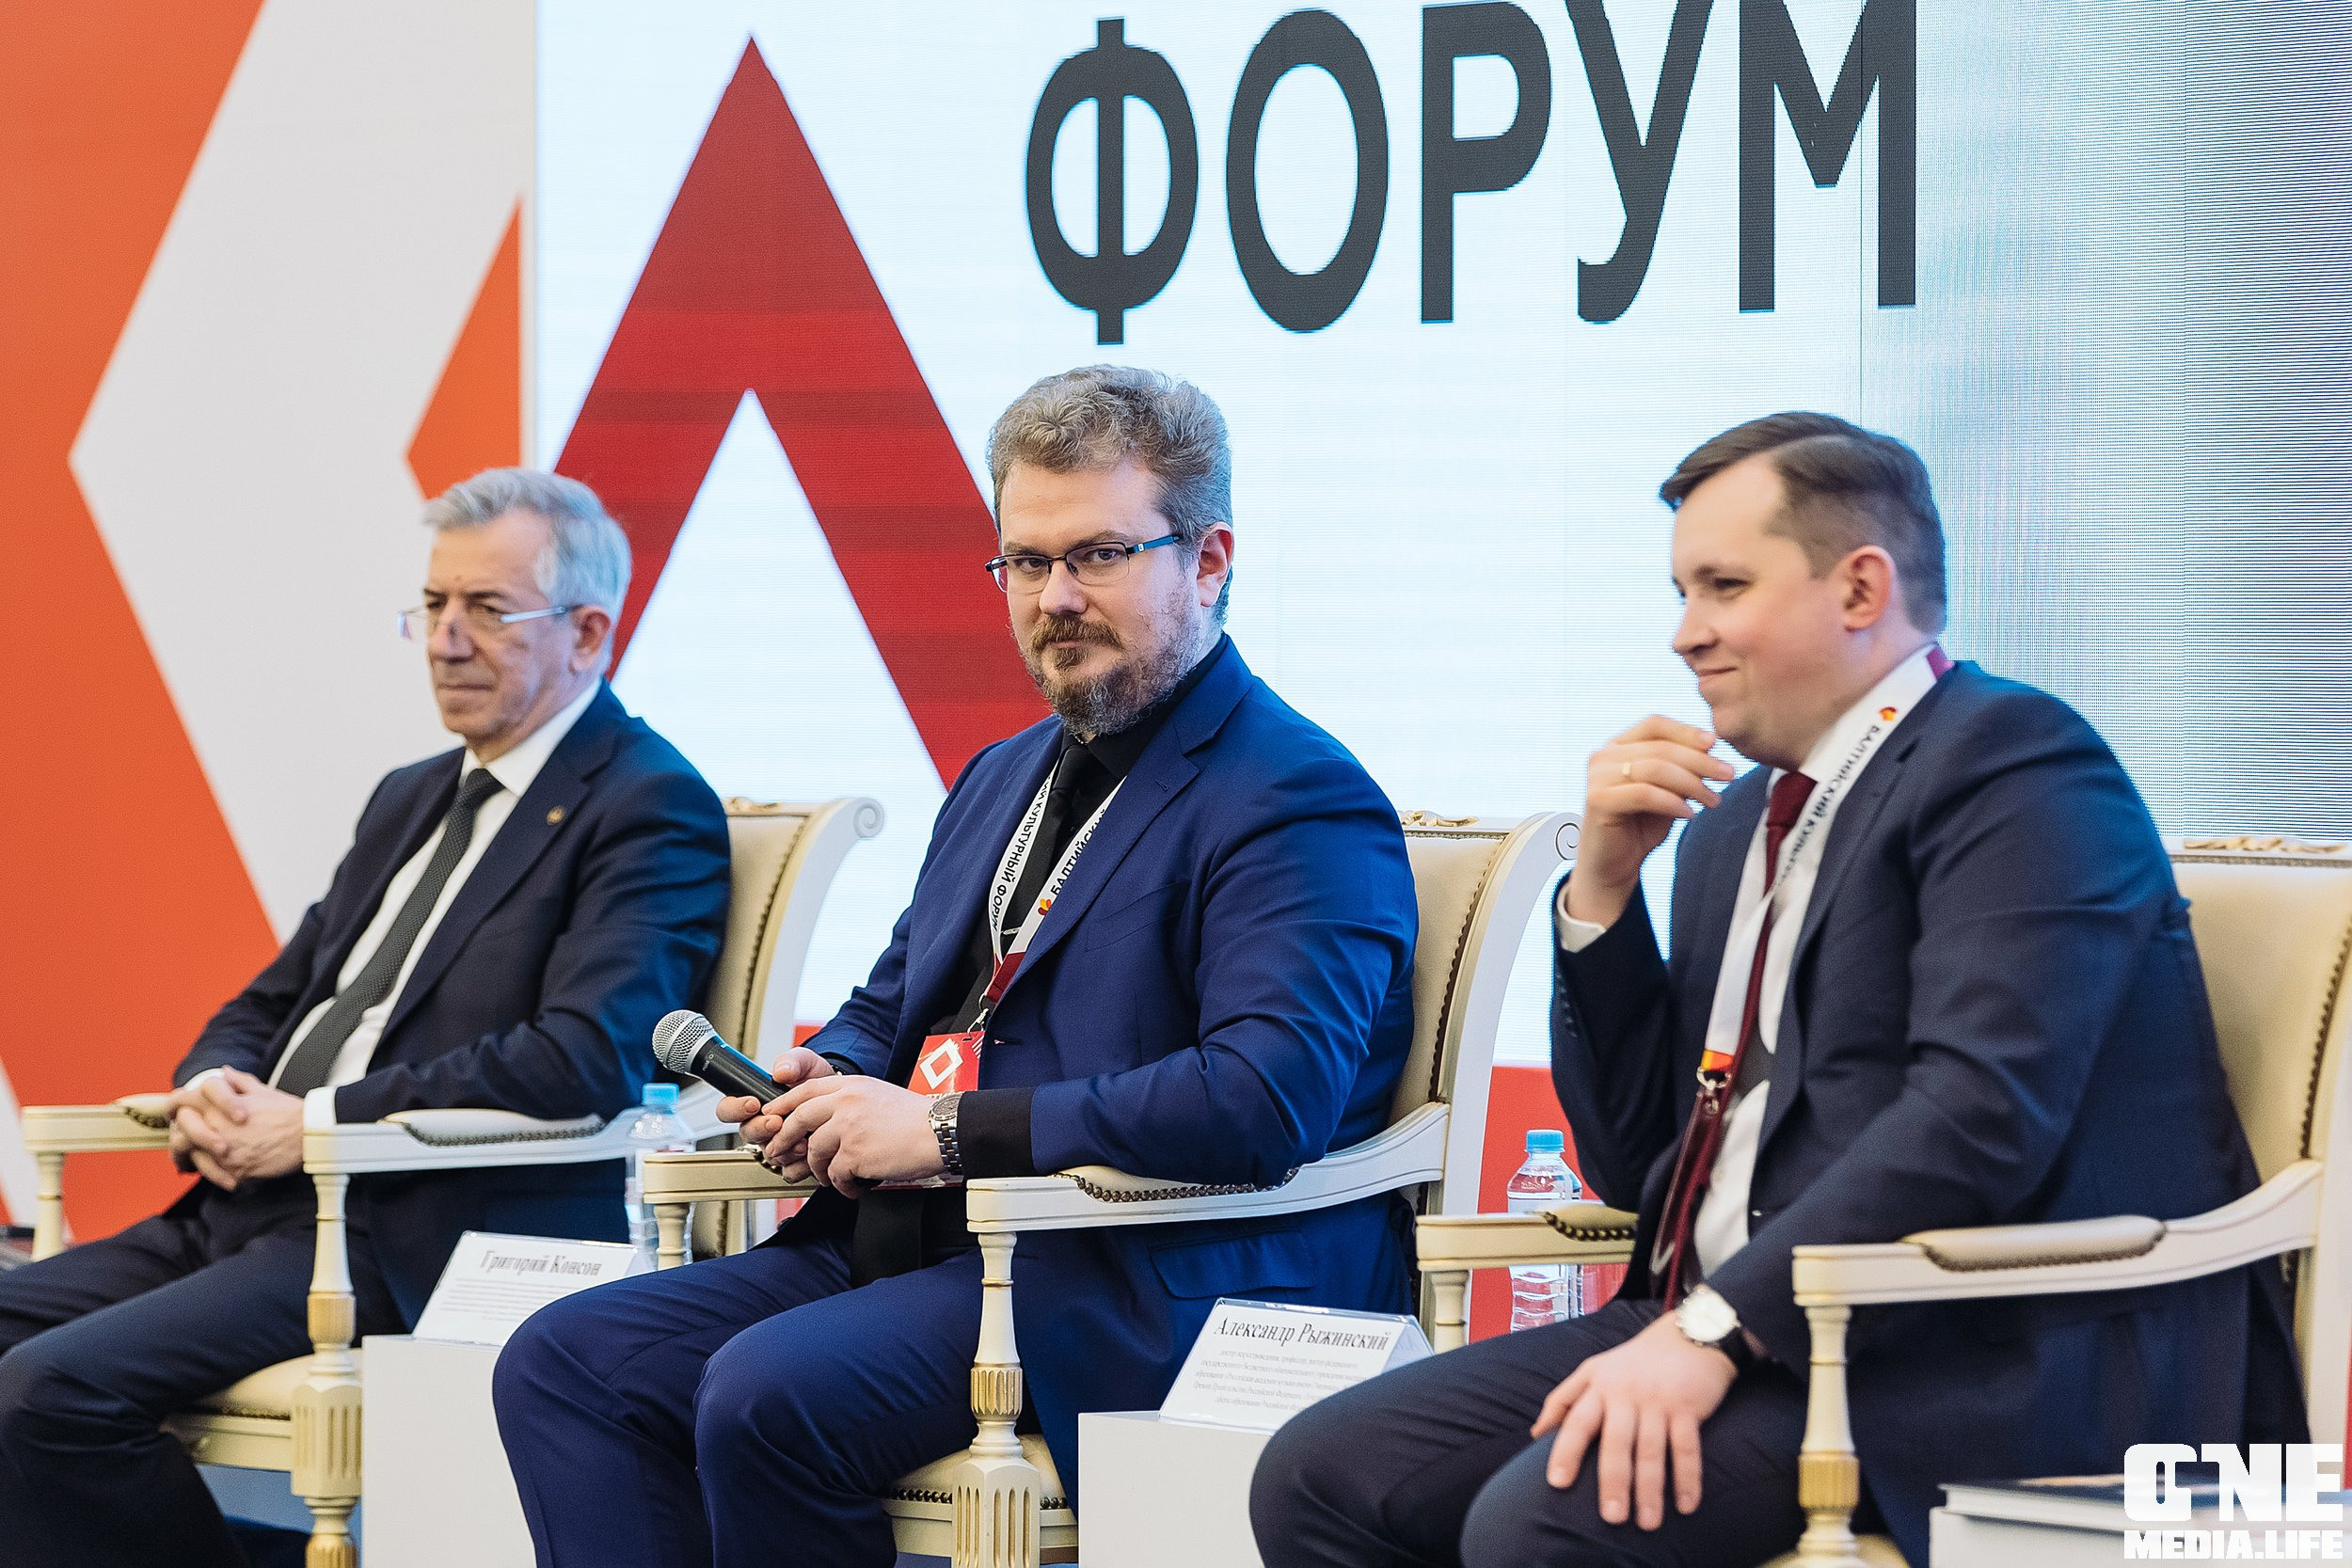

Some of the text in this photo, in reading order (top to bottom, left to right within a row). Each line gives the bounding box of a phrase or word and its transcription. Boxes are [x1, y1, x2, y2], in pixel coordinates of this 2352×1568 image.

[1026, 0, 1915, 344] ФОРУМ
[1000, 801, 1043, 883] КУЛЬТУРНЫЙ
[1214, 1317, 1391, 1352] Александр Рыжинский
